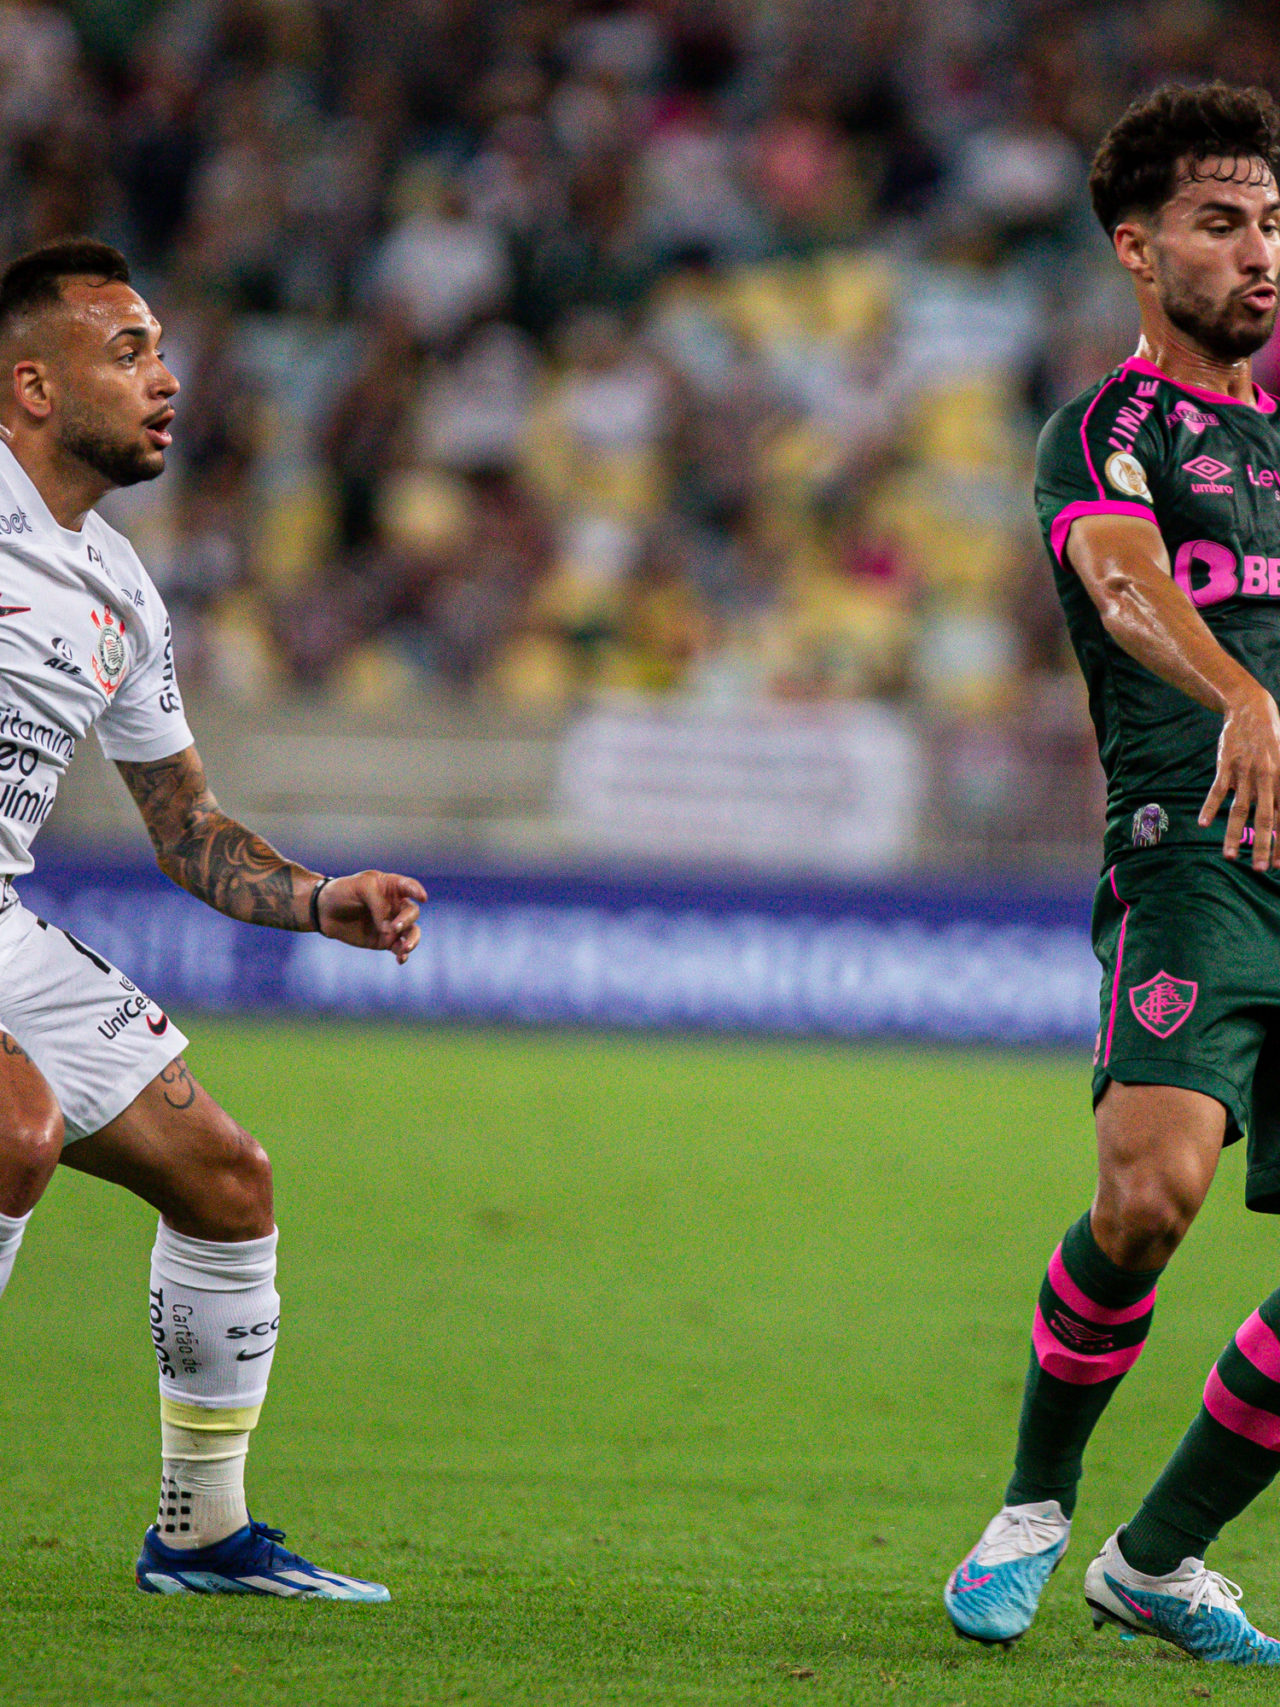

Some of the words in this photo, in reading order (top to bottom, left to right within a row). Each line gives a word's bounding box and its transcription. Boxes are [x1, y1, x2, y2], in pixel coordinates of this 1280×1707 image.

[1191, 481, 1234, 495] umbro
[43, 656, 82, 677] ALE
[150, 1287, 176, 1380] TODOS
